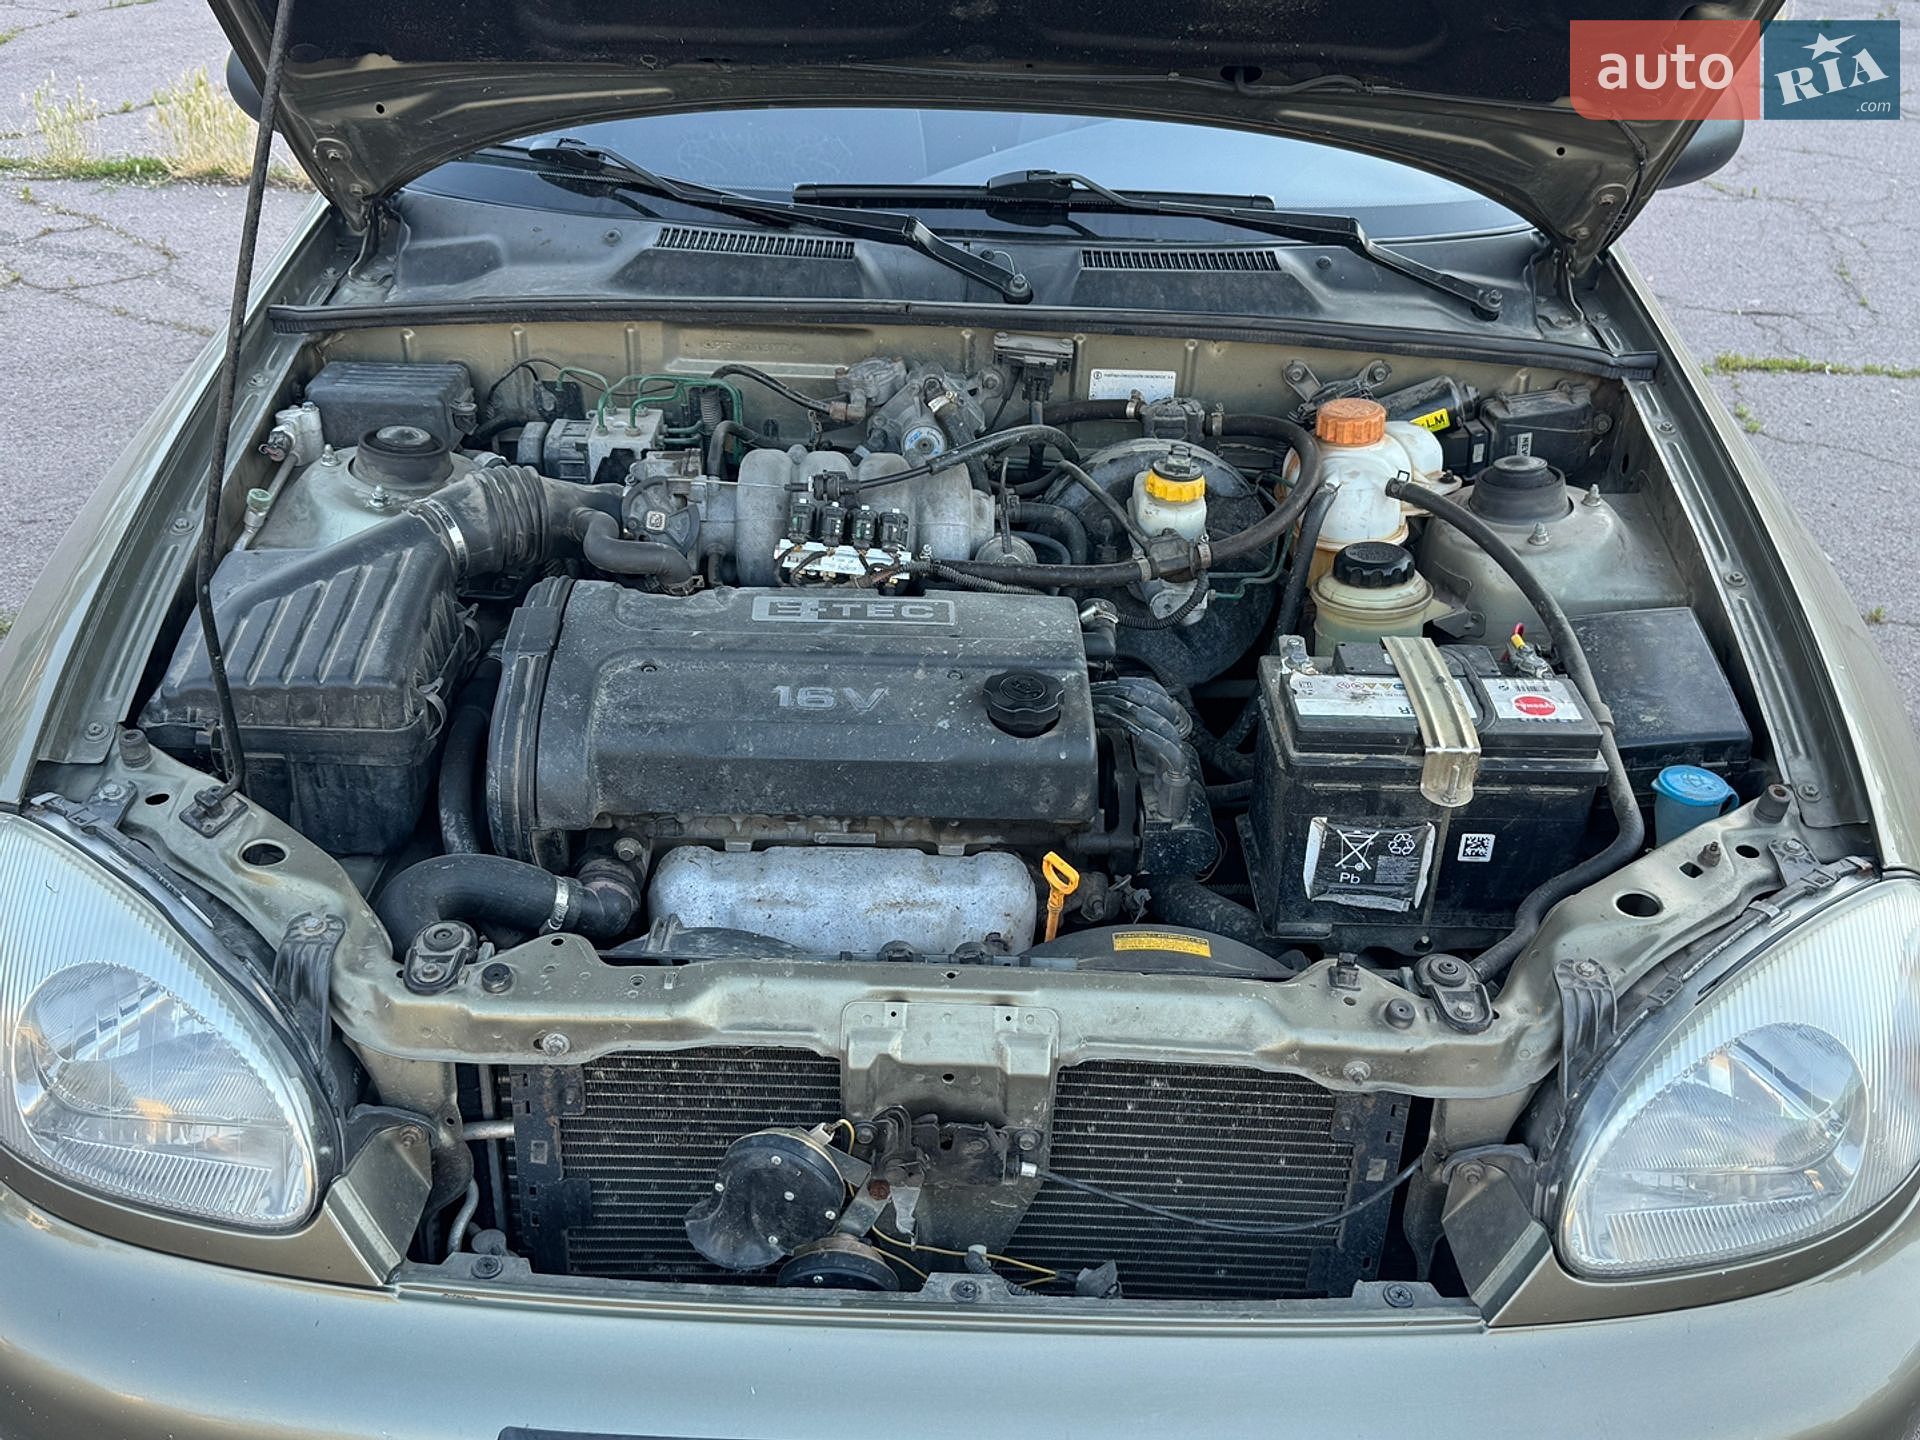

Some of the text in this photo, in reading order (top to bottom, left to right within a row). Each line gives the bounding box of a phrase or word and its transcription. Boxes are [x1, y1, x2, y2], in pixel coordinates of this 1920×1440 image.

[1421, 413, 1446, 428] LM
[773, 684, 889, 712] 16V
[1339, 872, 1361, 884] Pb
